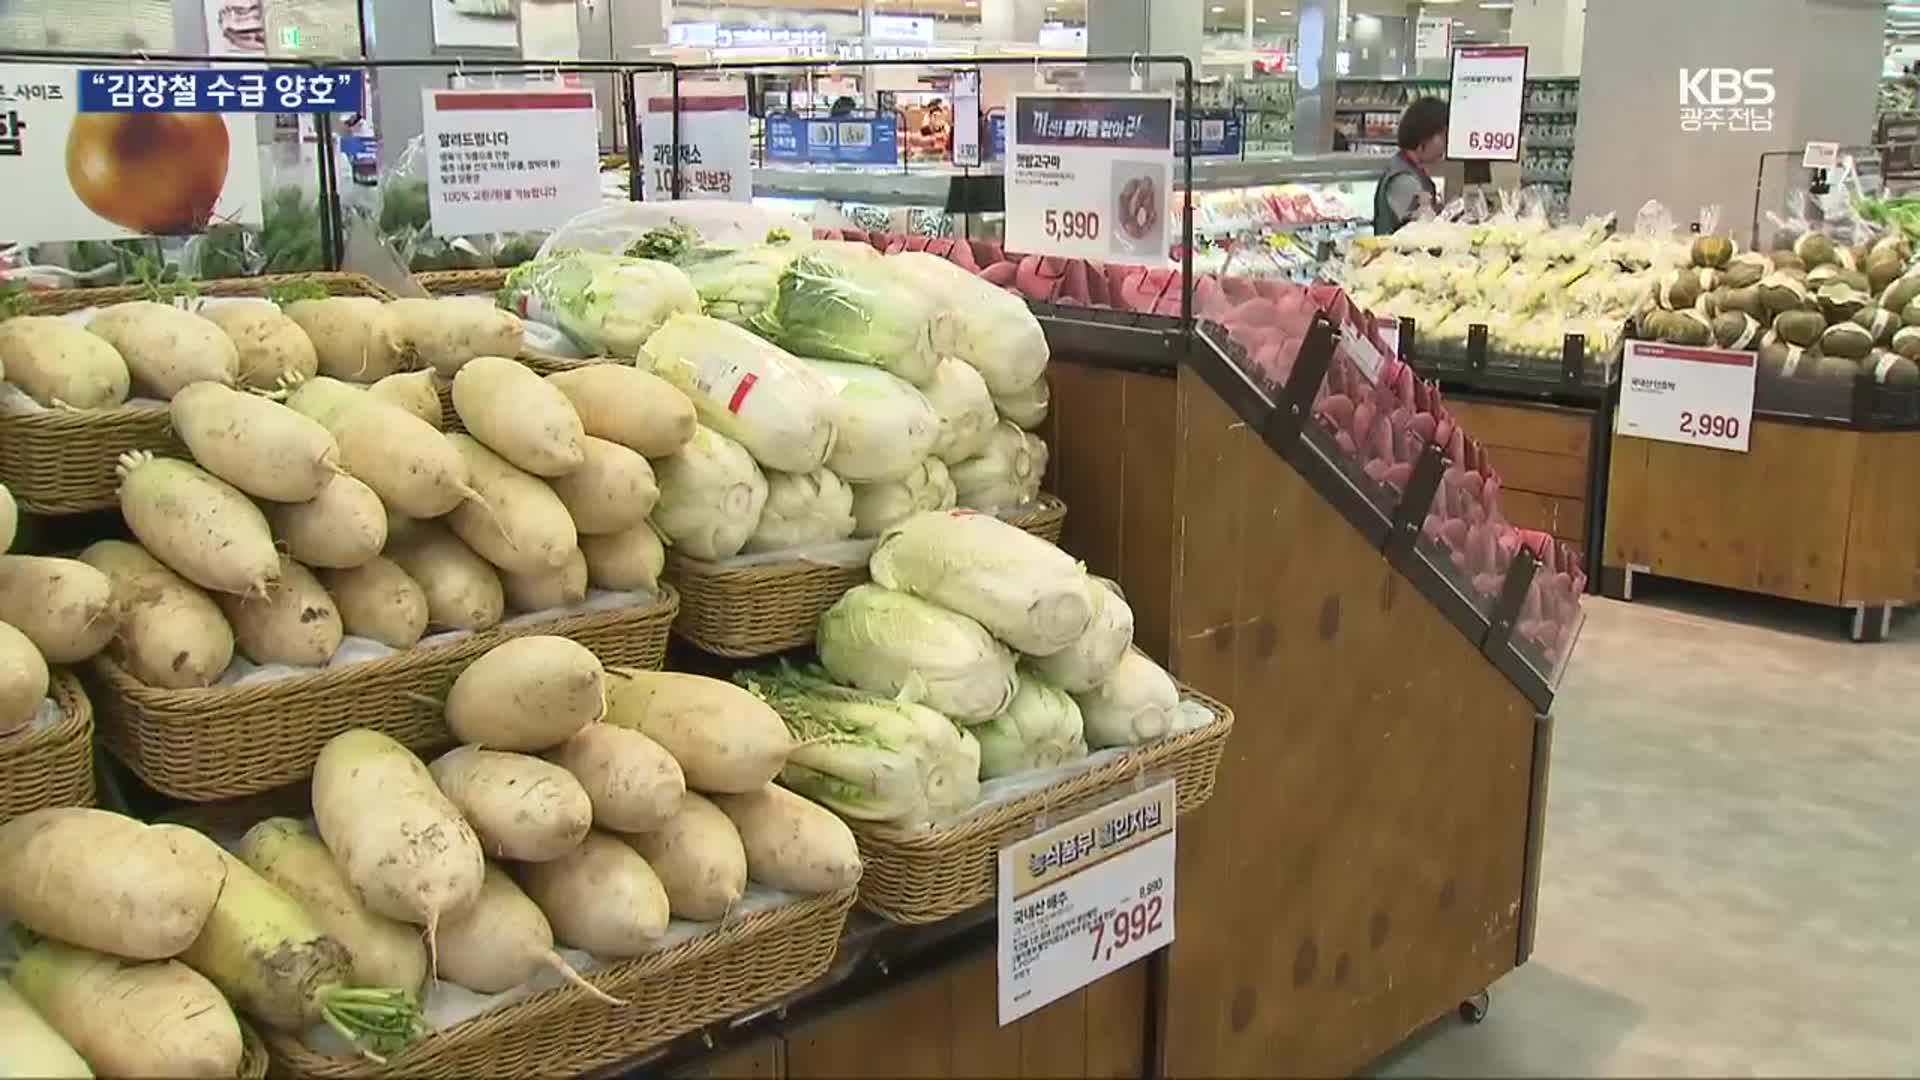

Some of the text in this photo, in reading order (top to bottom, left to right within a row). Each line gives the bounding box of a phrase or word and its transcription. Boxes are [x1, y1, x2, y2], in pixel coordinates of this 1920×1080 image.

[15, 84, 63, 101] 사이즈
[438, 131, 509, 148] 알려드립니다
[1469, 132, 1515, 151] 6,990
[695, 170, 731, 192] 맛보장
[443, 191, 471, 203] 100%
[1045, 209, 1099, 242] 5,990
[1680, 411, 1739, 439] 2,990
[1029, 828, 1095, 877] 농식품부
[1089, 896, 1162, 960] 7,992
